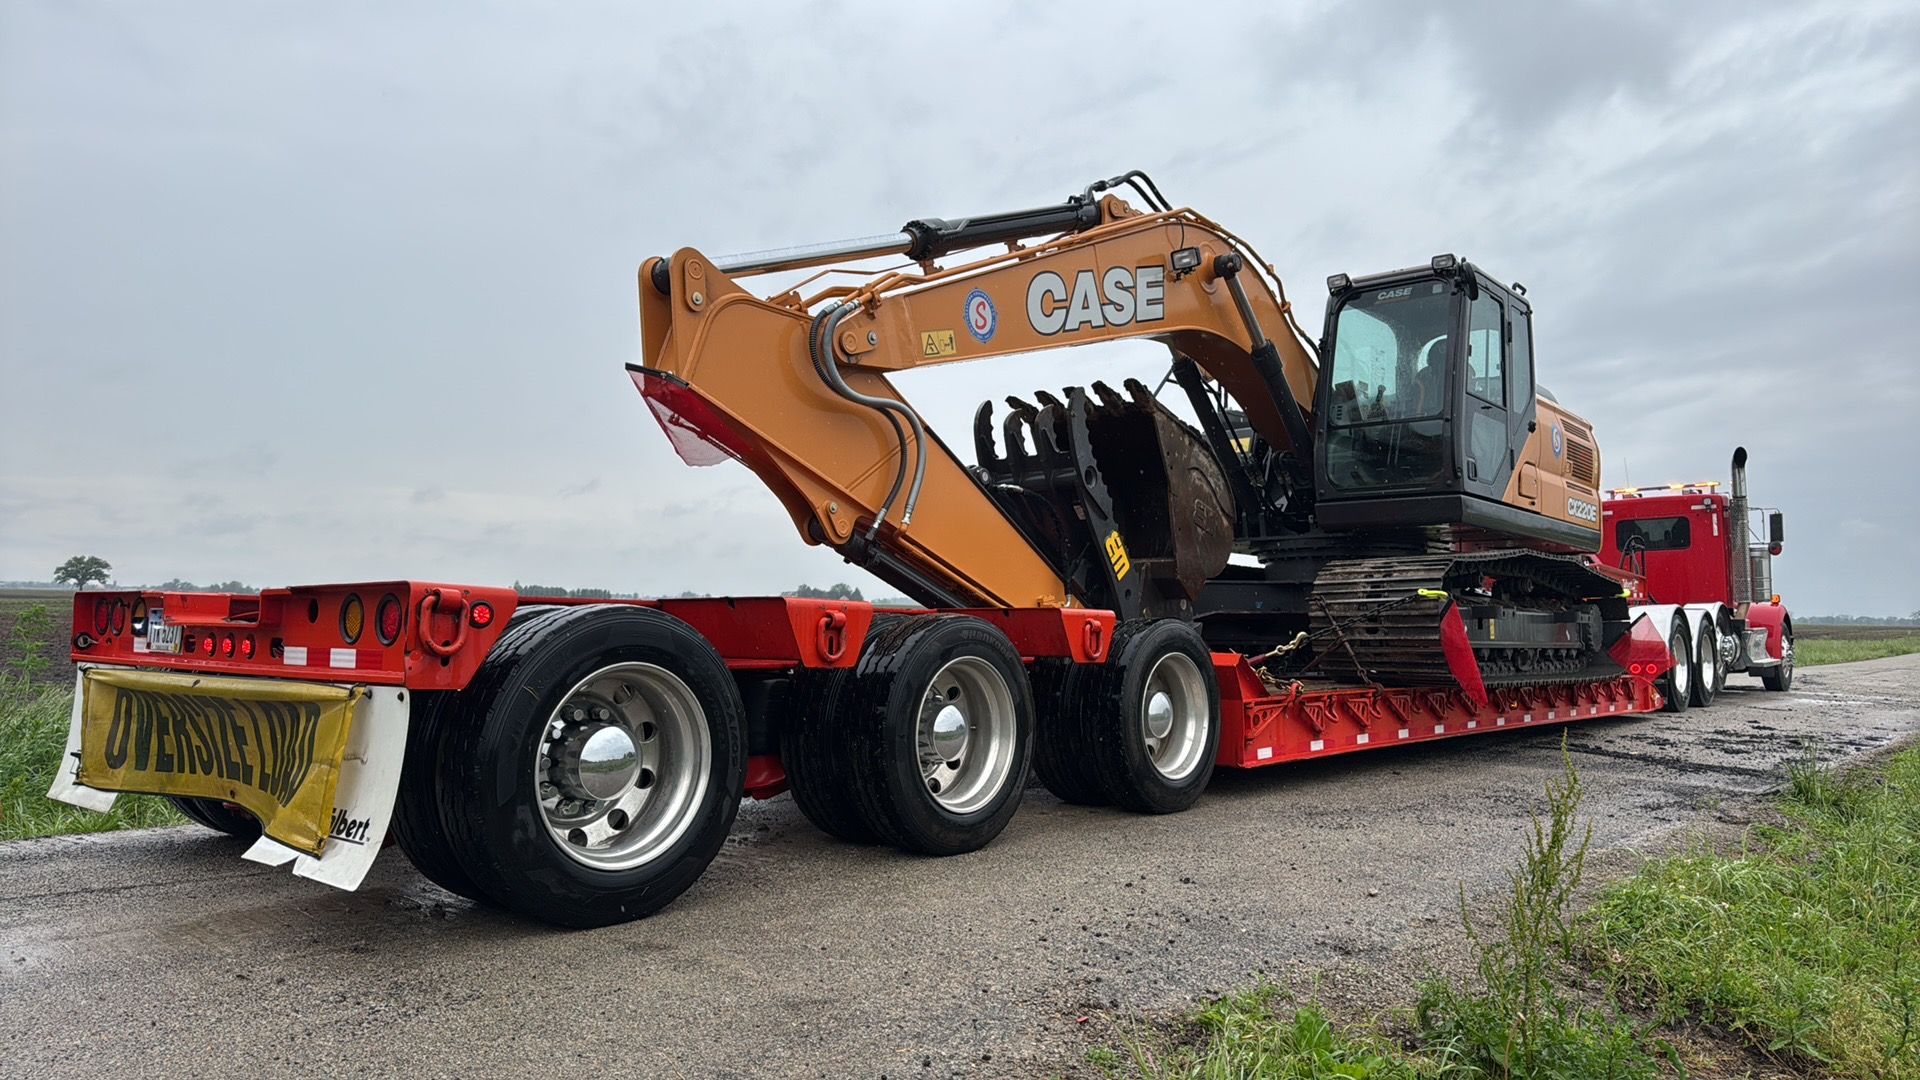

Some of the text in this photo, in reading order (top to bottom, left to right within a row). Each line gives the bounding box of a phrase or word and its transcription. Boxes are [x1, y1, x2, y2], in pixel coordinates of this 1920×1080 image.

[1026, 264, 1165, 336] CASE
[1377, 287, 1413, 300] CASE
[975, 301, 988, 331] S
[1567, 497, 1597, 522] CX220E
[104, 687, 321, 808] OVERSIZE LOAD
